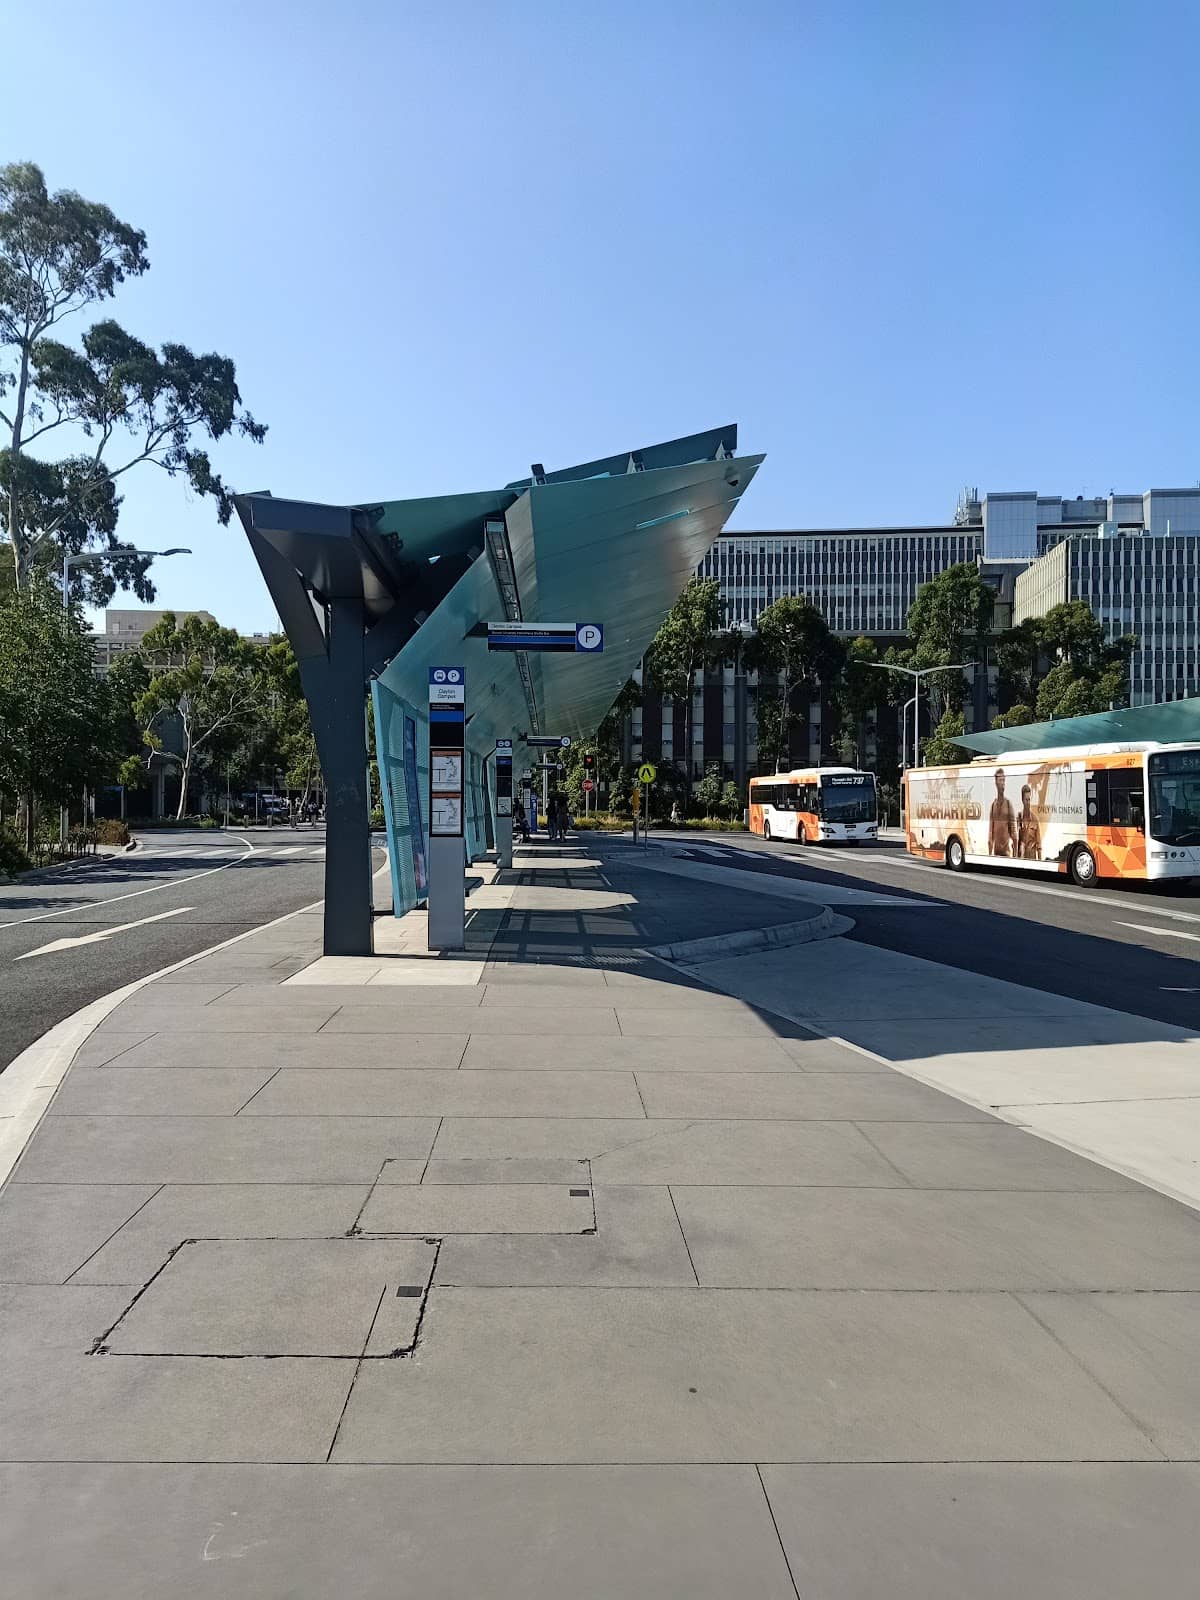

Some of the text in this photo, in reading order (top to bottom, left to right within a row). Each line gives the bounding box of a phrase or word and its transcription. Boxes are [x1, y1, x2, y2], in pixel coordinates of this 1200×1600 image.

[586, 631, 595, 643] P
[852, 776, 865, 785] 737
[916, 802, 982, 820] UNCHARTED
[1037, 806, 1050, 815] ONLY
[1058, 806, 1083, 815] CINEMAS
